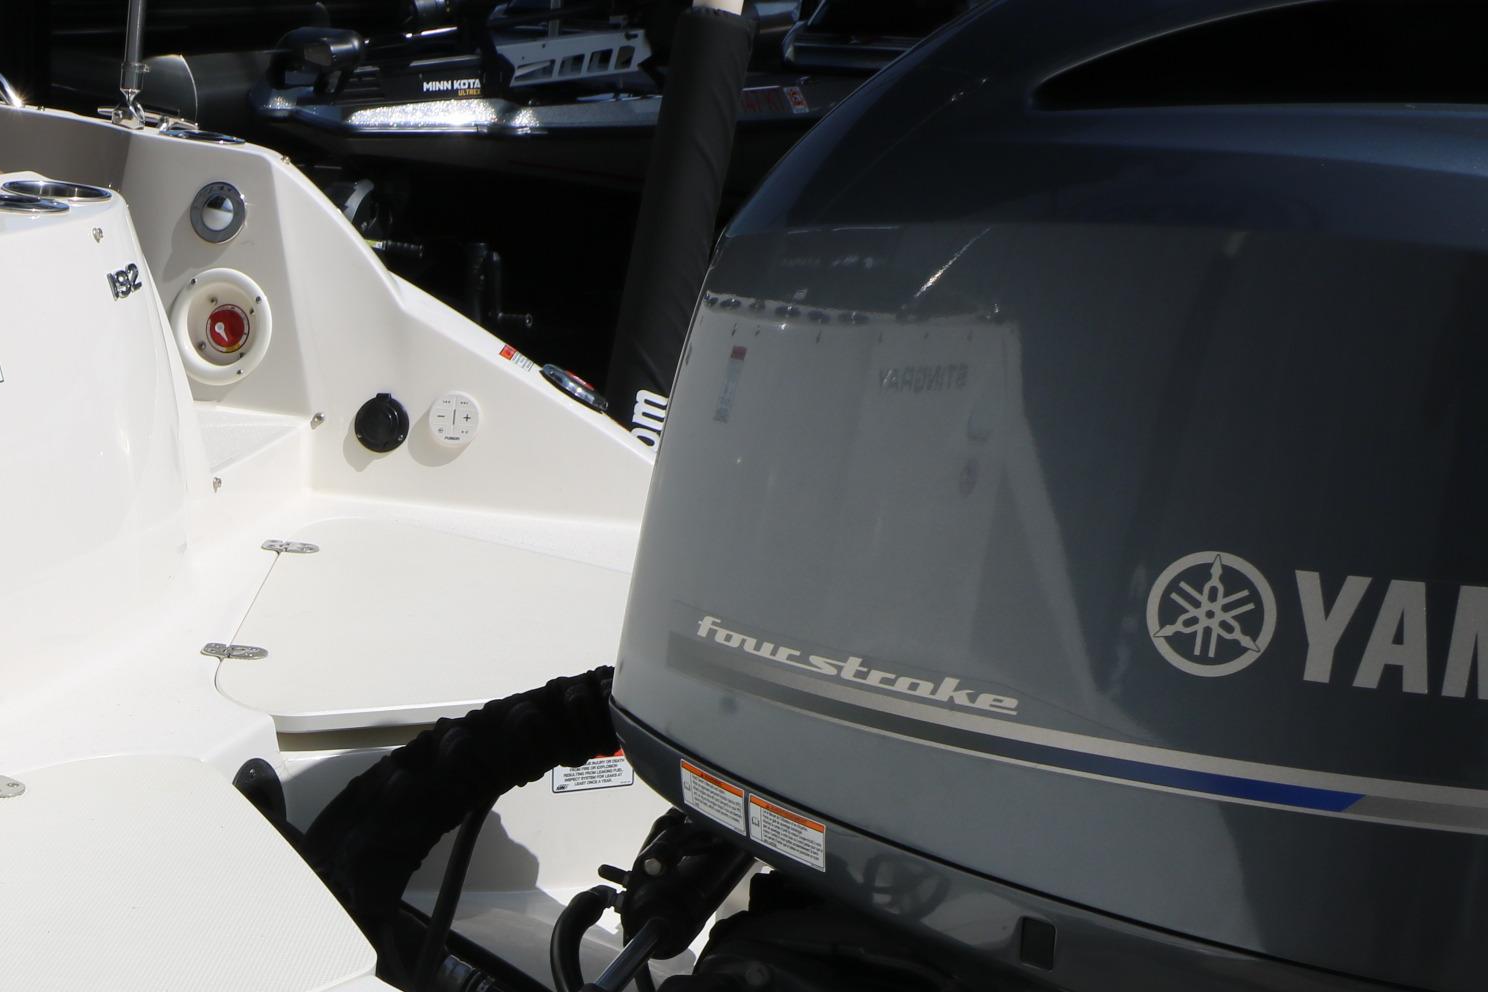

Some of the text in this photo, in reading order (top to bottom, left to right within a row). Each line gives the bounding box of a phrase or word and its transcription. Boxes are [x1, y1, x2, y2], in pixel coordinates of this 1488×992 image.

[423, 78, 481, 91] MINN KOTA
[106, 263, 142, 301] 192
